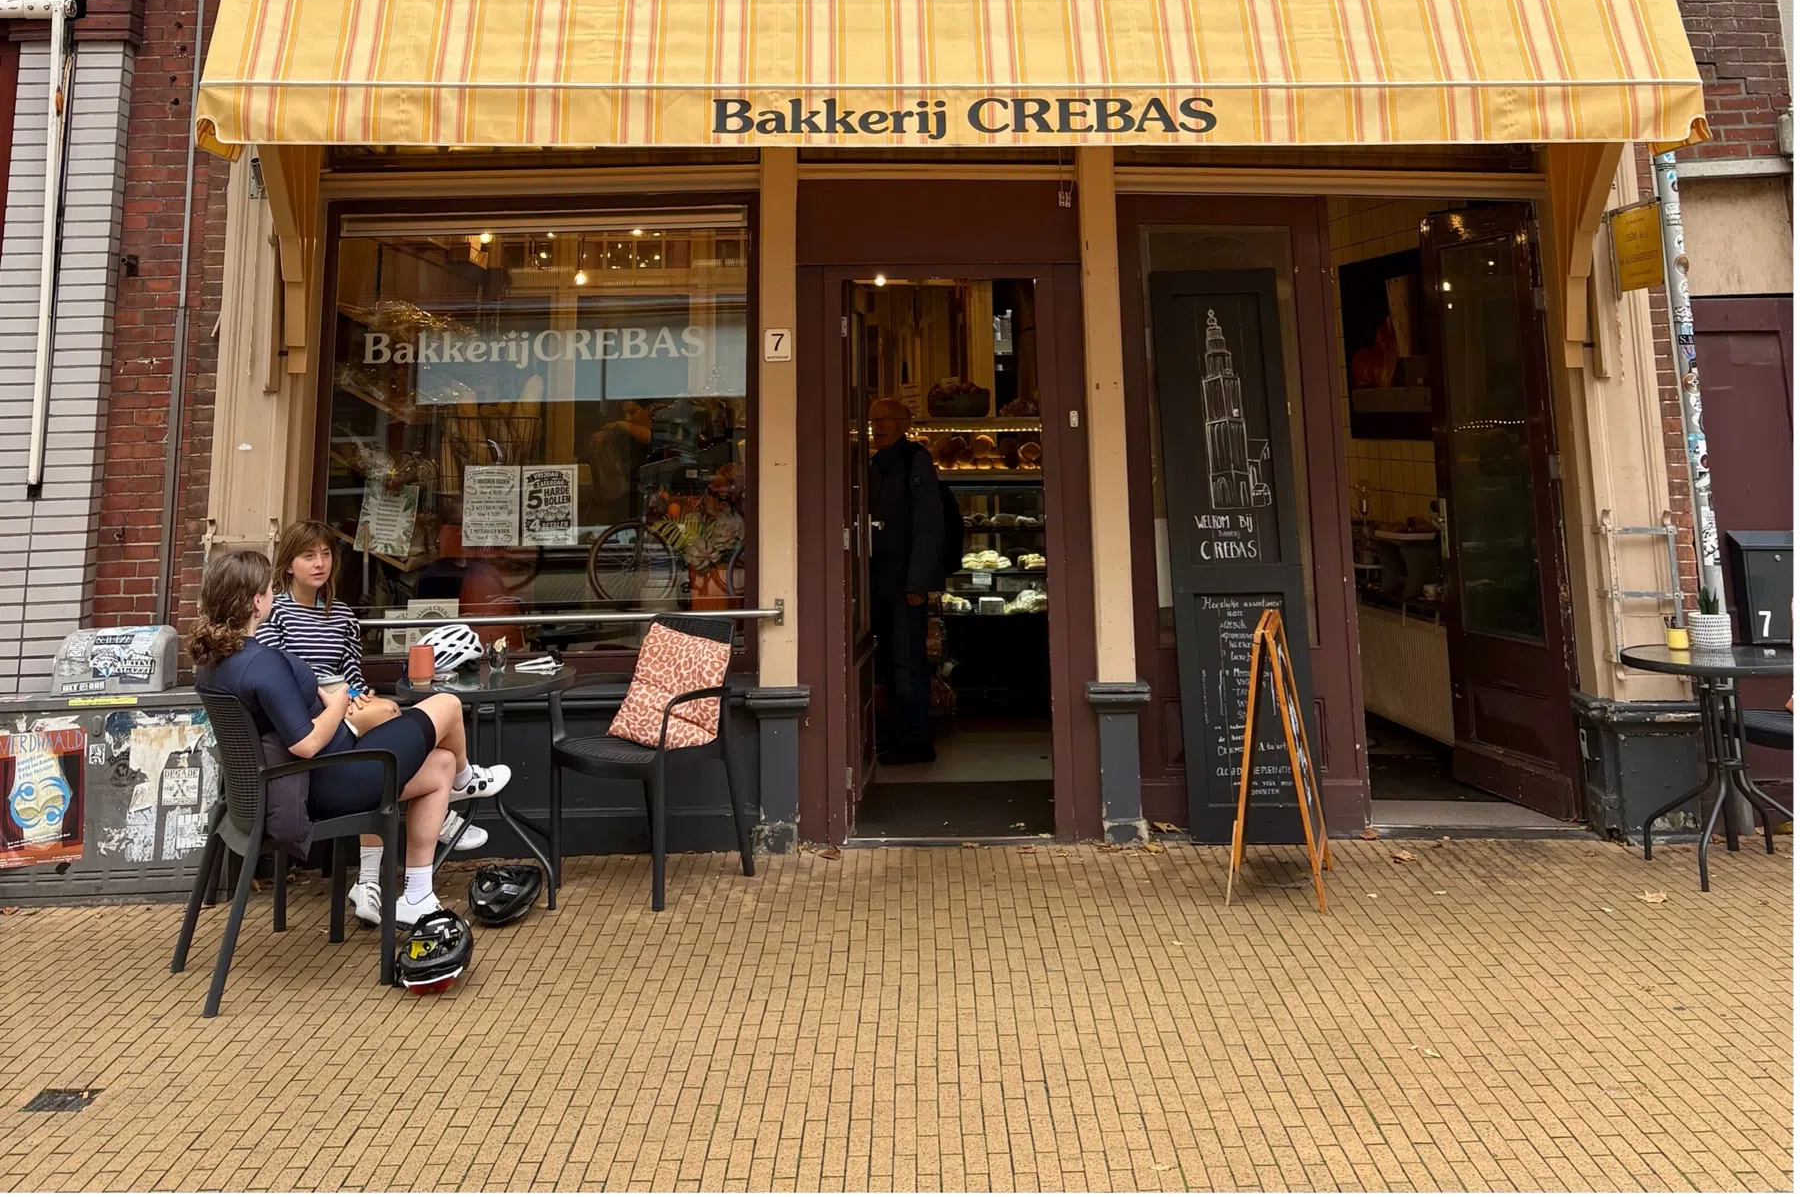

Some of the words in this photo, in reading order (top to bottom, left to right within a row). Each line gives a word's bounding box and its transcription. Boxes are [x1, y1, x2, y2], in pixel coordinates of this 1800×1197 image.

[712, 97, 948, 140] Bakkerij
[967, 97, 1218, 134] CREBAS
[771, 333, 785, 352] 7
[526, 488, 543, 509] 5
[543, 486, 570, 497] HARDE
[544, 495, 571, 506] BOLLEN
[1194, 514, 1230, 529] WELKOM
[1200, 540, 1258, 560] CREBAS
[1758, 610, 1772, 638] 7
[0, 730, 84, 755] VERDWAALD
